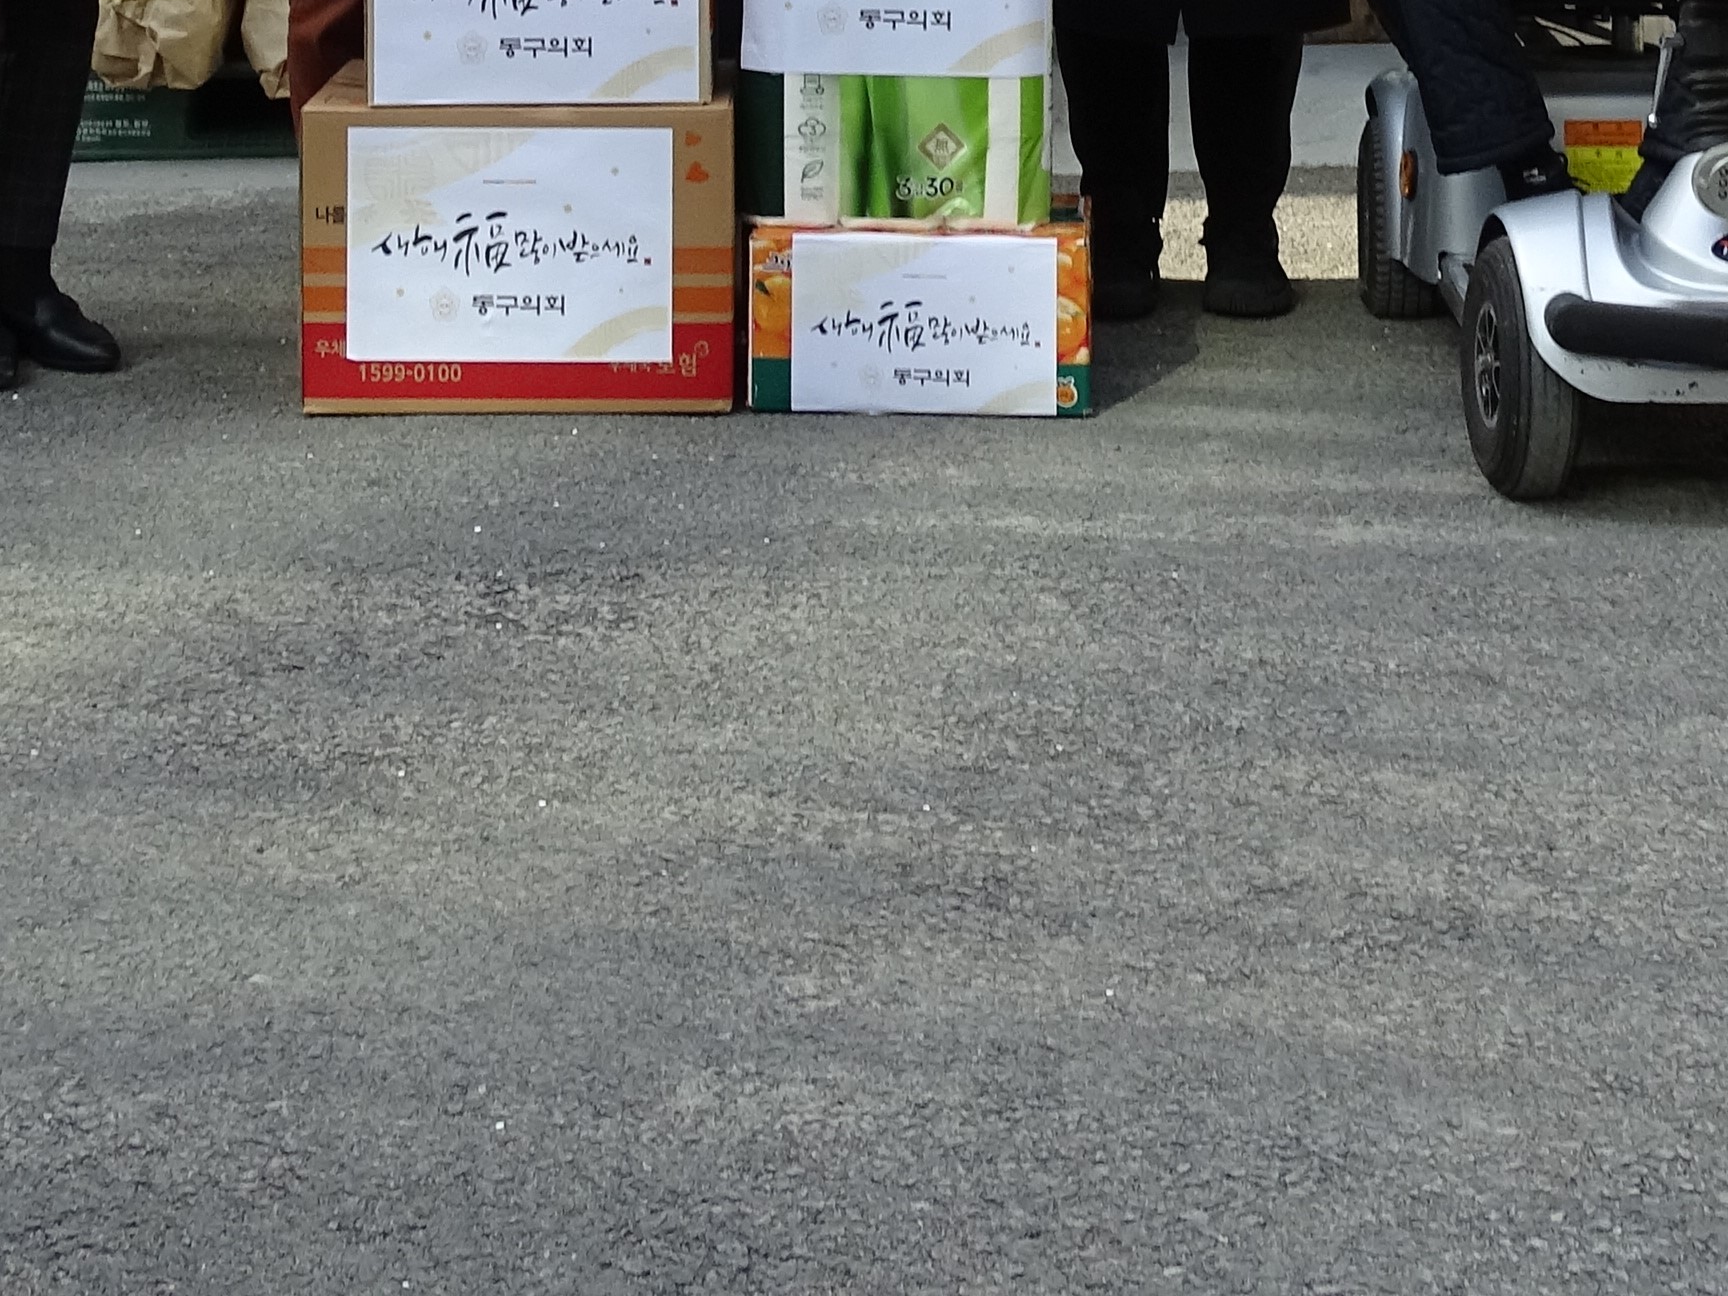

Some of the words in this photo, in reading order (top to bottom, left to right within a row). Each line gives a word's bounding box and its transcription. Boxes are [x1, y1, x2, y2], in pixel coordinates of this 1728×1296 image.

[859, 9, 952, 31] 동구의회
[500, 37, 592, 58] 동구의회
[472, 294, 565, 317] 동구의회
[893, 368, 971, 389] 동구의회
